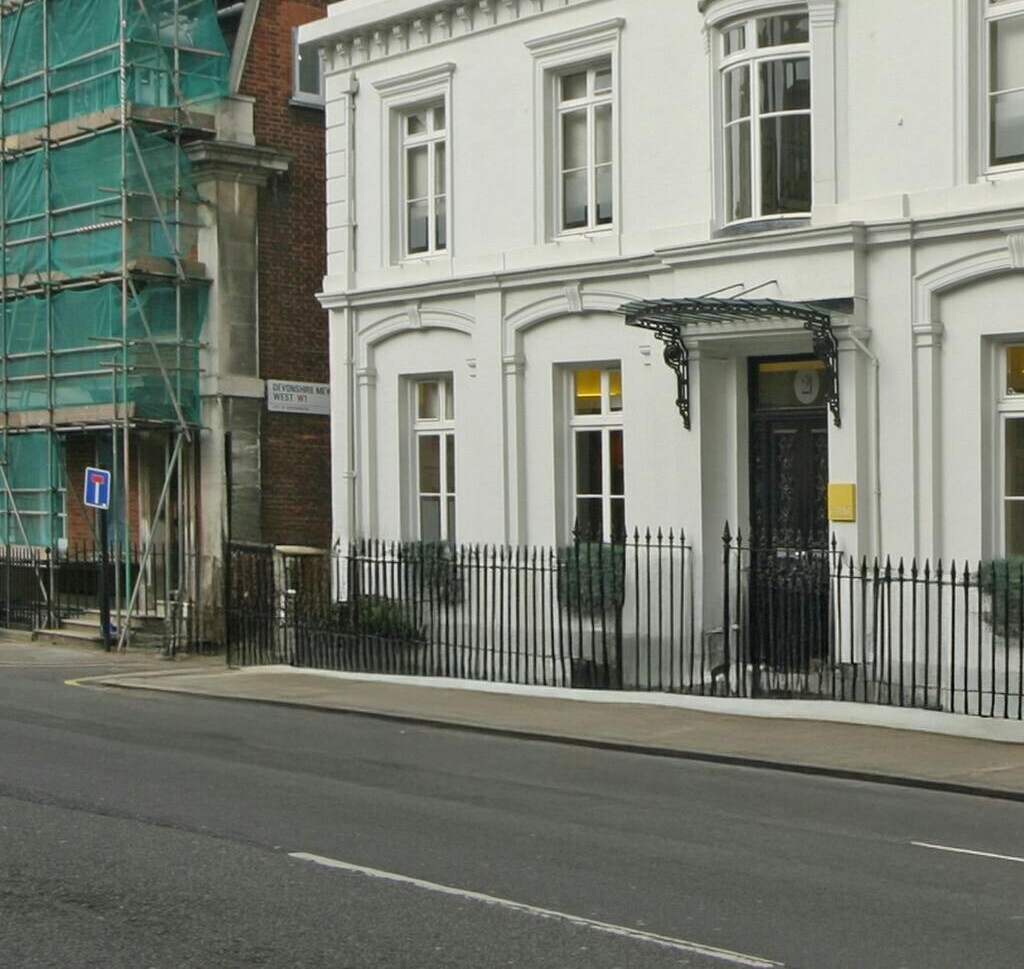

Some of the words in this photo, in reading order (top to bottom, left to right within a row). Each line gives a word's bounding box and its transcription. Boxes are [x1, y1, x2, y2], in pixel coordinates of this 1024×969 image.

[272, 383, 314, 394] DEVONSHIRE
[273, 393, 293, 401] WEST
[297, 394, 307, 403] W1
